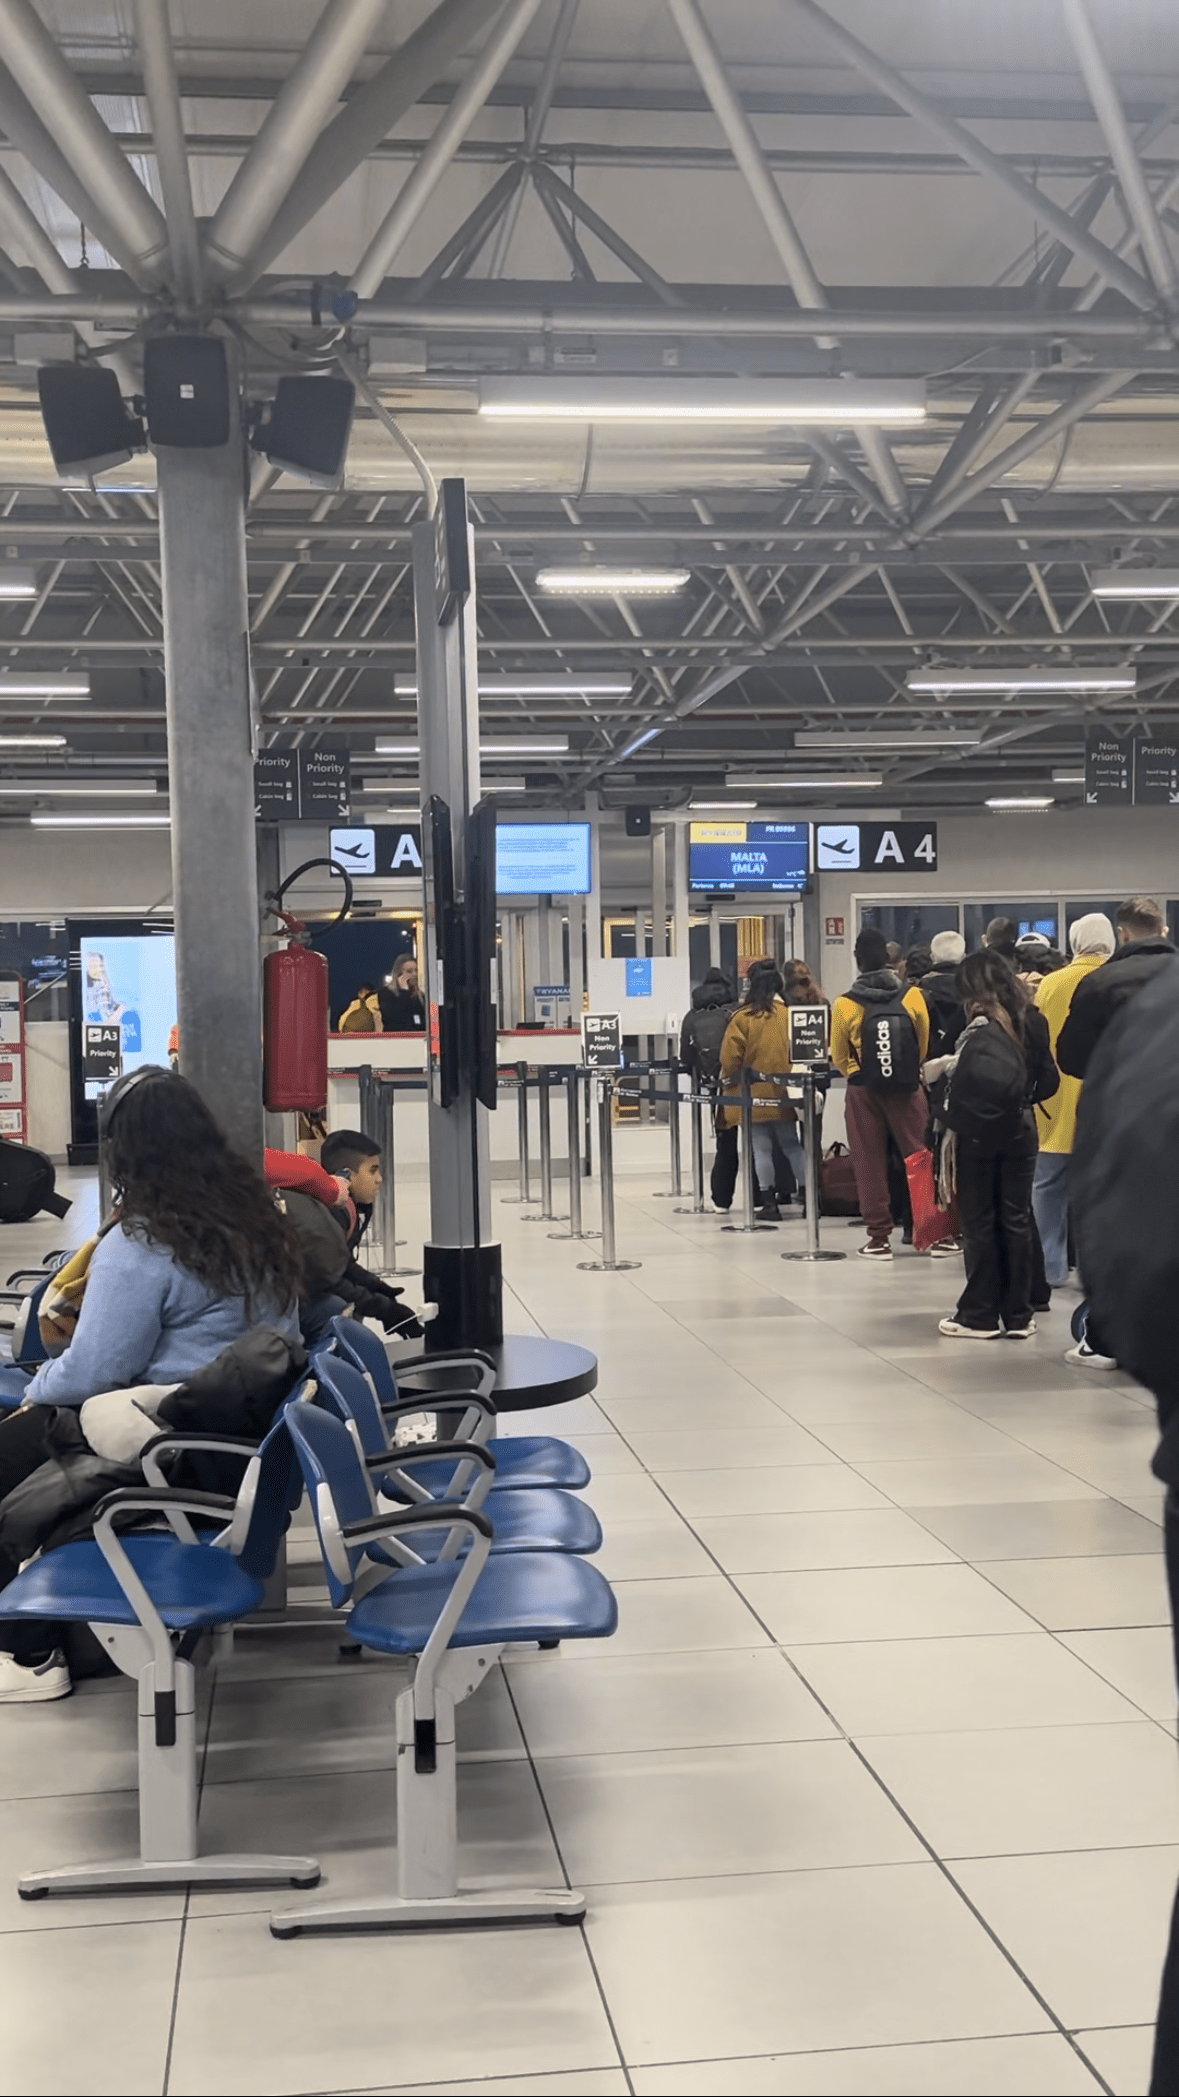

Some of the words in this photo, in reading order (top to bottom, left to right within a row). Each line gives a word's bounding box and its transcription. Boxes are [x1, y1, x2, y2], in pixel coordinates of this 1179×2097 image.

[1099, 742, 1119, 750] Non
[1141, 746, 1177, 757] Priority
[314, 752, 336, 761] Non
[1091, 752, 1126, 763] Priority
[307, 763, 344, 775] Priority
[390, 834, 423, 868] A
[874, 830, 905, 864] A
[914, 833, 936, 863] 4
[730, 852, 768, 862] MALTA
[732, 863, 765, 875] (MLA)
[601, 1019, 617, 1030] A3
[808, 1014, 823, 1025] A4
[103, 1030, 118, 1041] A3
[589, 1043, 616, 1052] Priority
[796, 1038, 822, 1046] Priority
[90, 1049, 117, 1059] Priority
[876, 1020, 893, 1077] adidas
